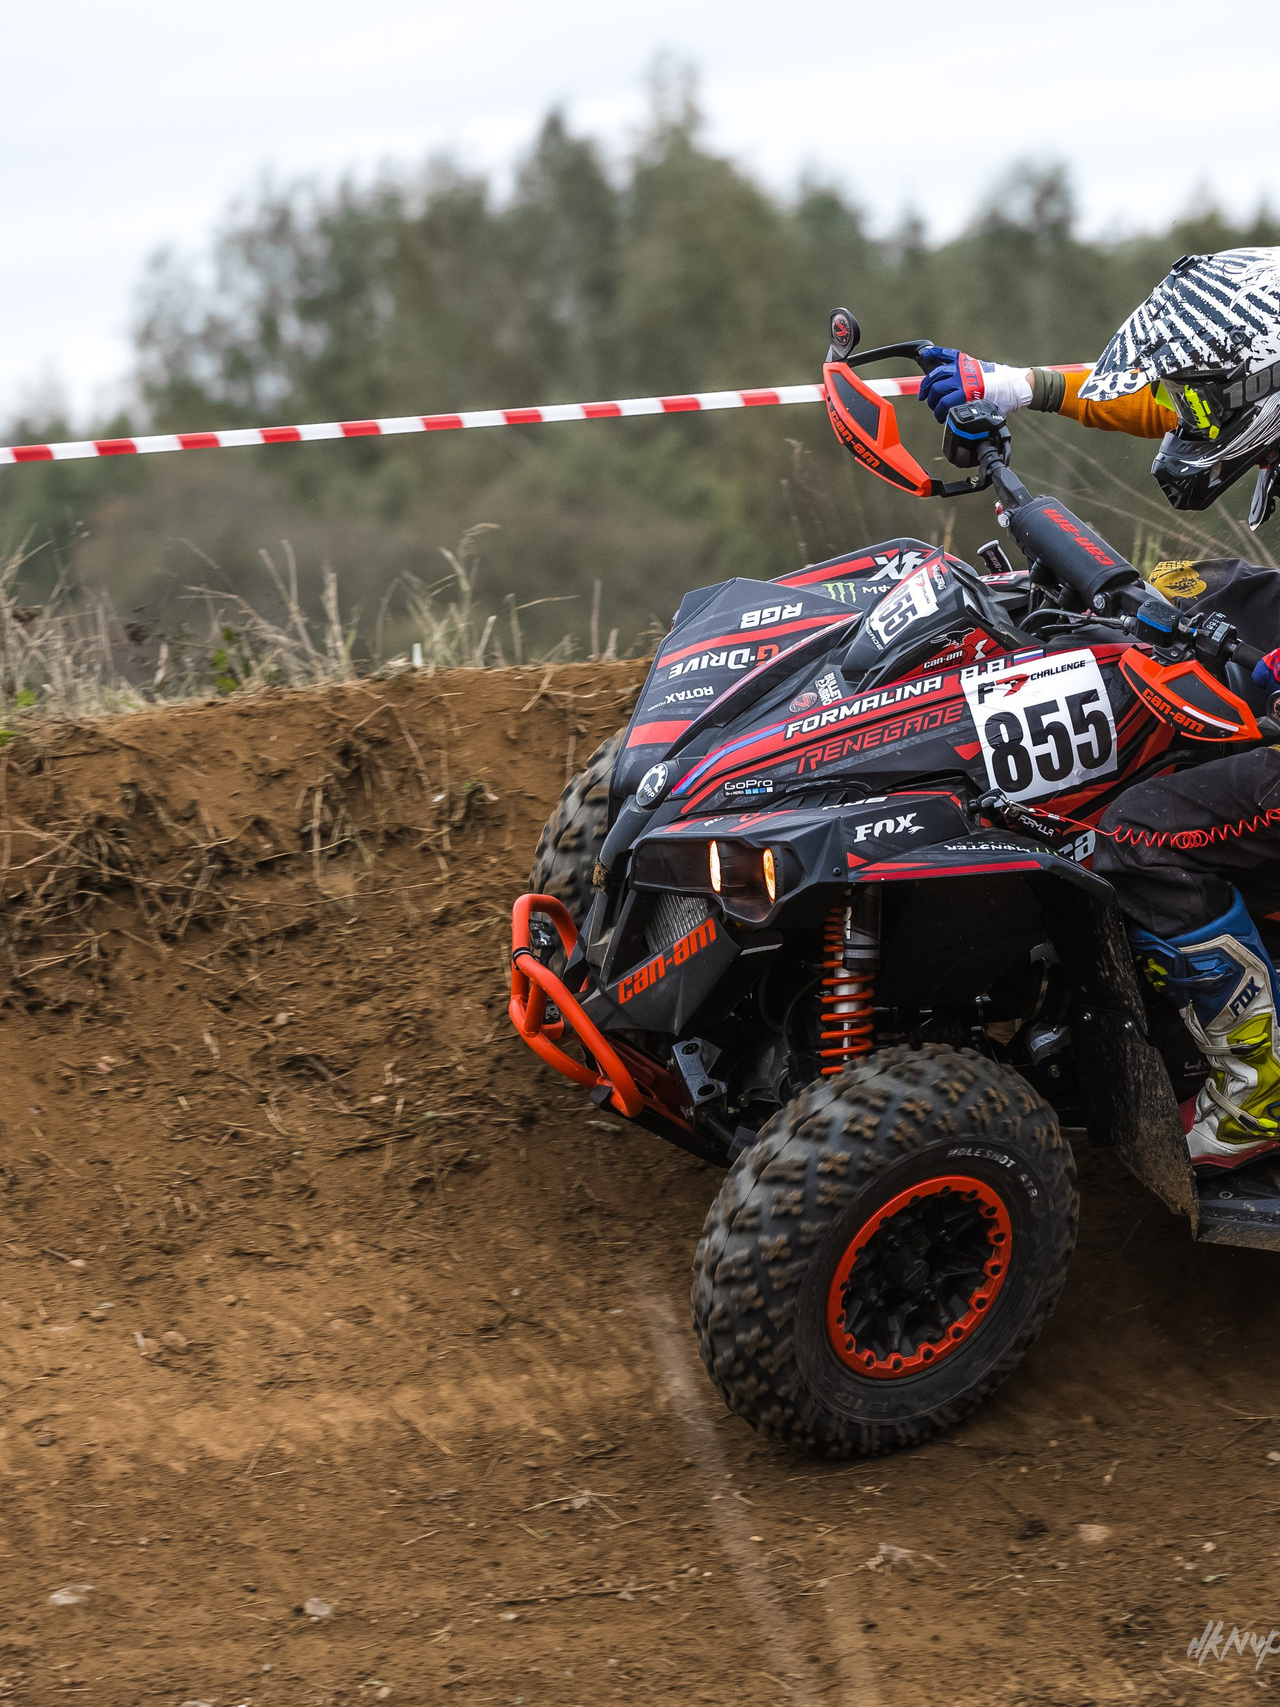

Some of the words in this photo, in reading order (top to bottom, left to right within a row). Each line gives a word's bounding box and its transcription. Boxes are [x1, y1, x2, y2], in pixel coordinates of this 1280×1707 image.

[1043, 508, 1116, 566] can-am
[740, 602, 804, 629] RGB
[923, 650, 963, 669] can-am
[1029, 659, 1087, 681] CHALLENGE
[665, 685, 715, 704] ROTAX
[824, 671, 843, 701] BULLET
[785, 674, 944, 741] FORMALINA
[1142, 687, 1206, 734] can-am
[797, 703, 967, 774] RENEGADE
[983, 688, 1115, 795] 855
[724, 779, 773, 791] GoPro
[853, 811, 922, 843] FOX
[618, 918, 717, 1005] can-am
[1230, 974, 1262, 1017] FOX
[946, 1147, 1017, 1170] HOLESHOT
